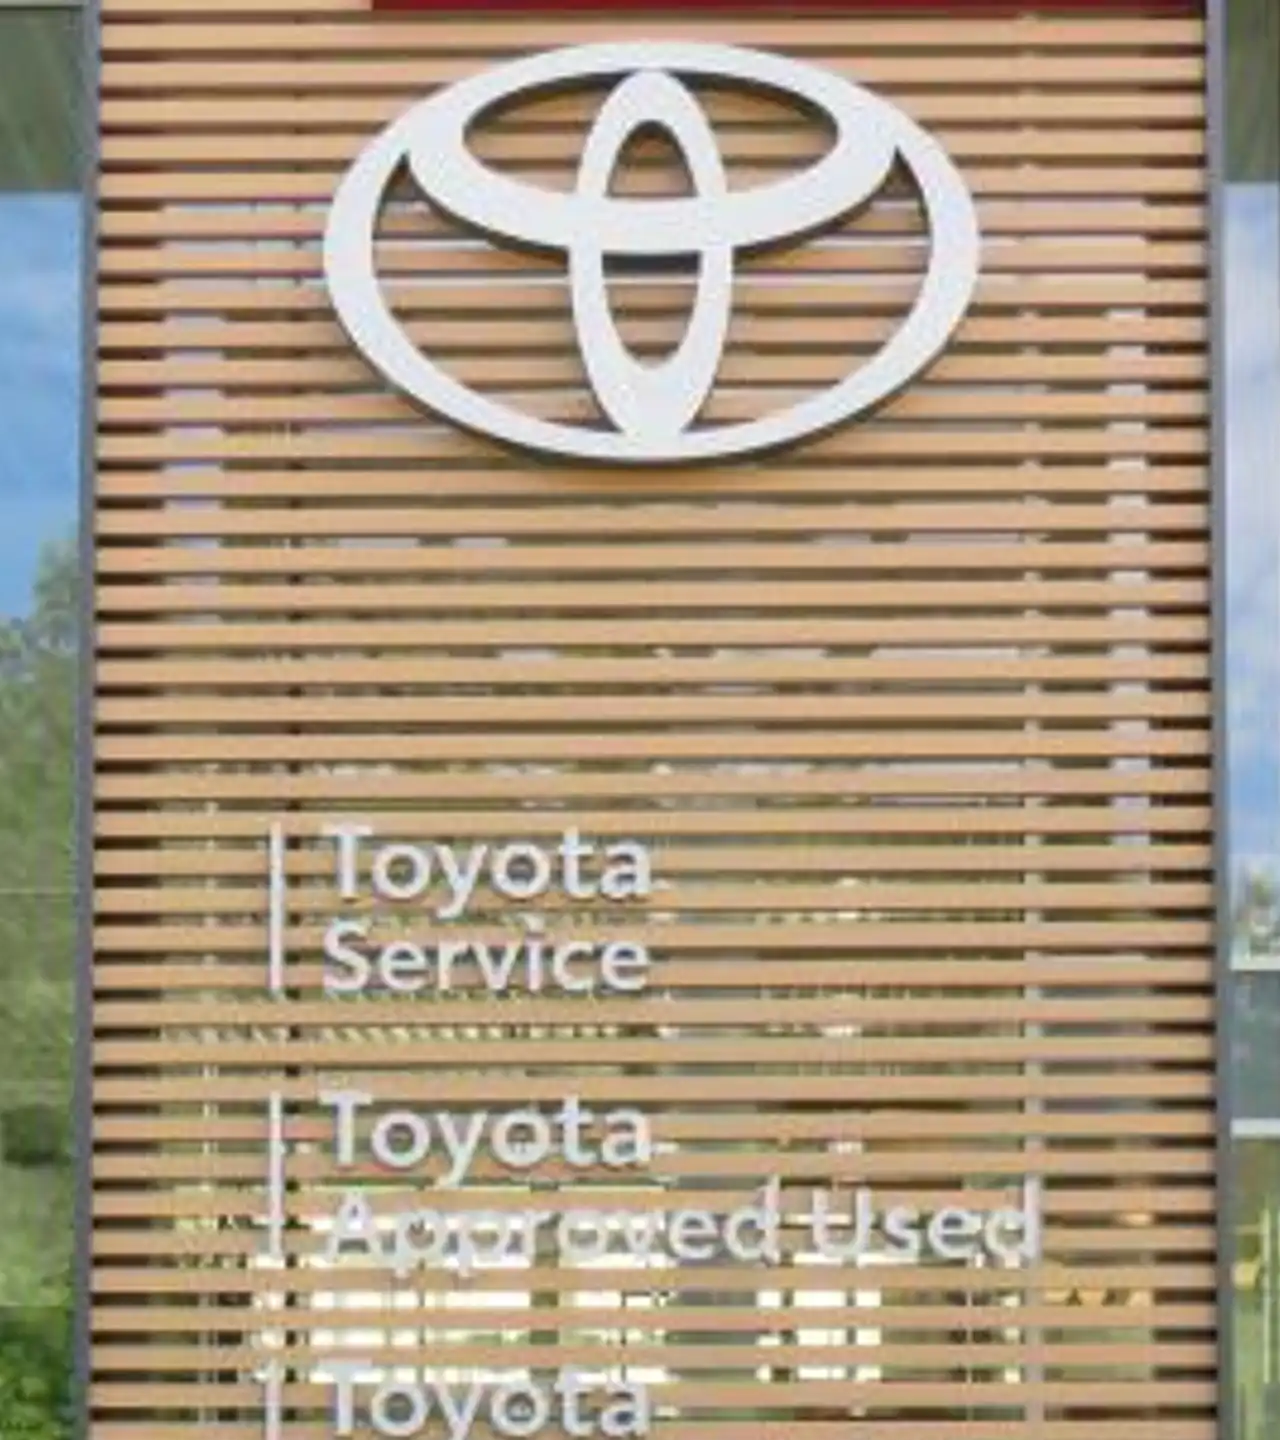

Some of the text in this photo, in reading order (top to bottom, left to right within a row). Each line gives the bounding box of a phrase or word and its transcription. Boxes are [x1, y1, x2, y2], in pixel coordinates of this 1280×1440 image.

[321, 822, 652, 919] Toyota
[323, 915, 650, 992] Service
[321, 1092, 652, 1188] Toyota
[323, 1174, 1042, 1279] Approved Used
